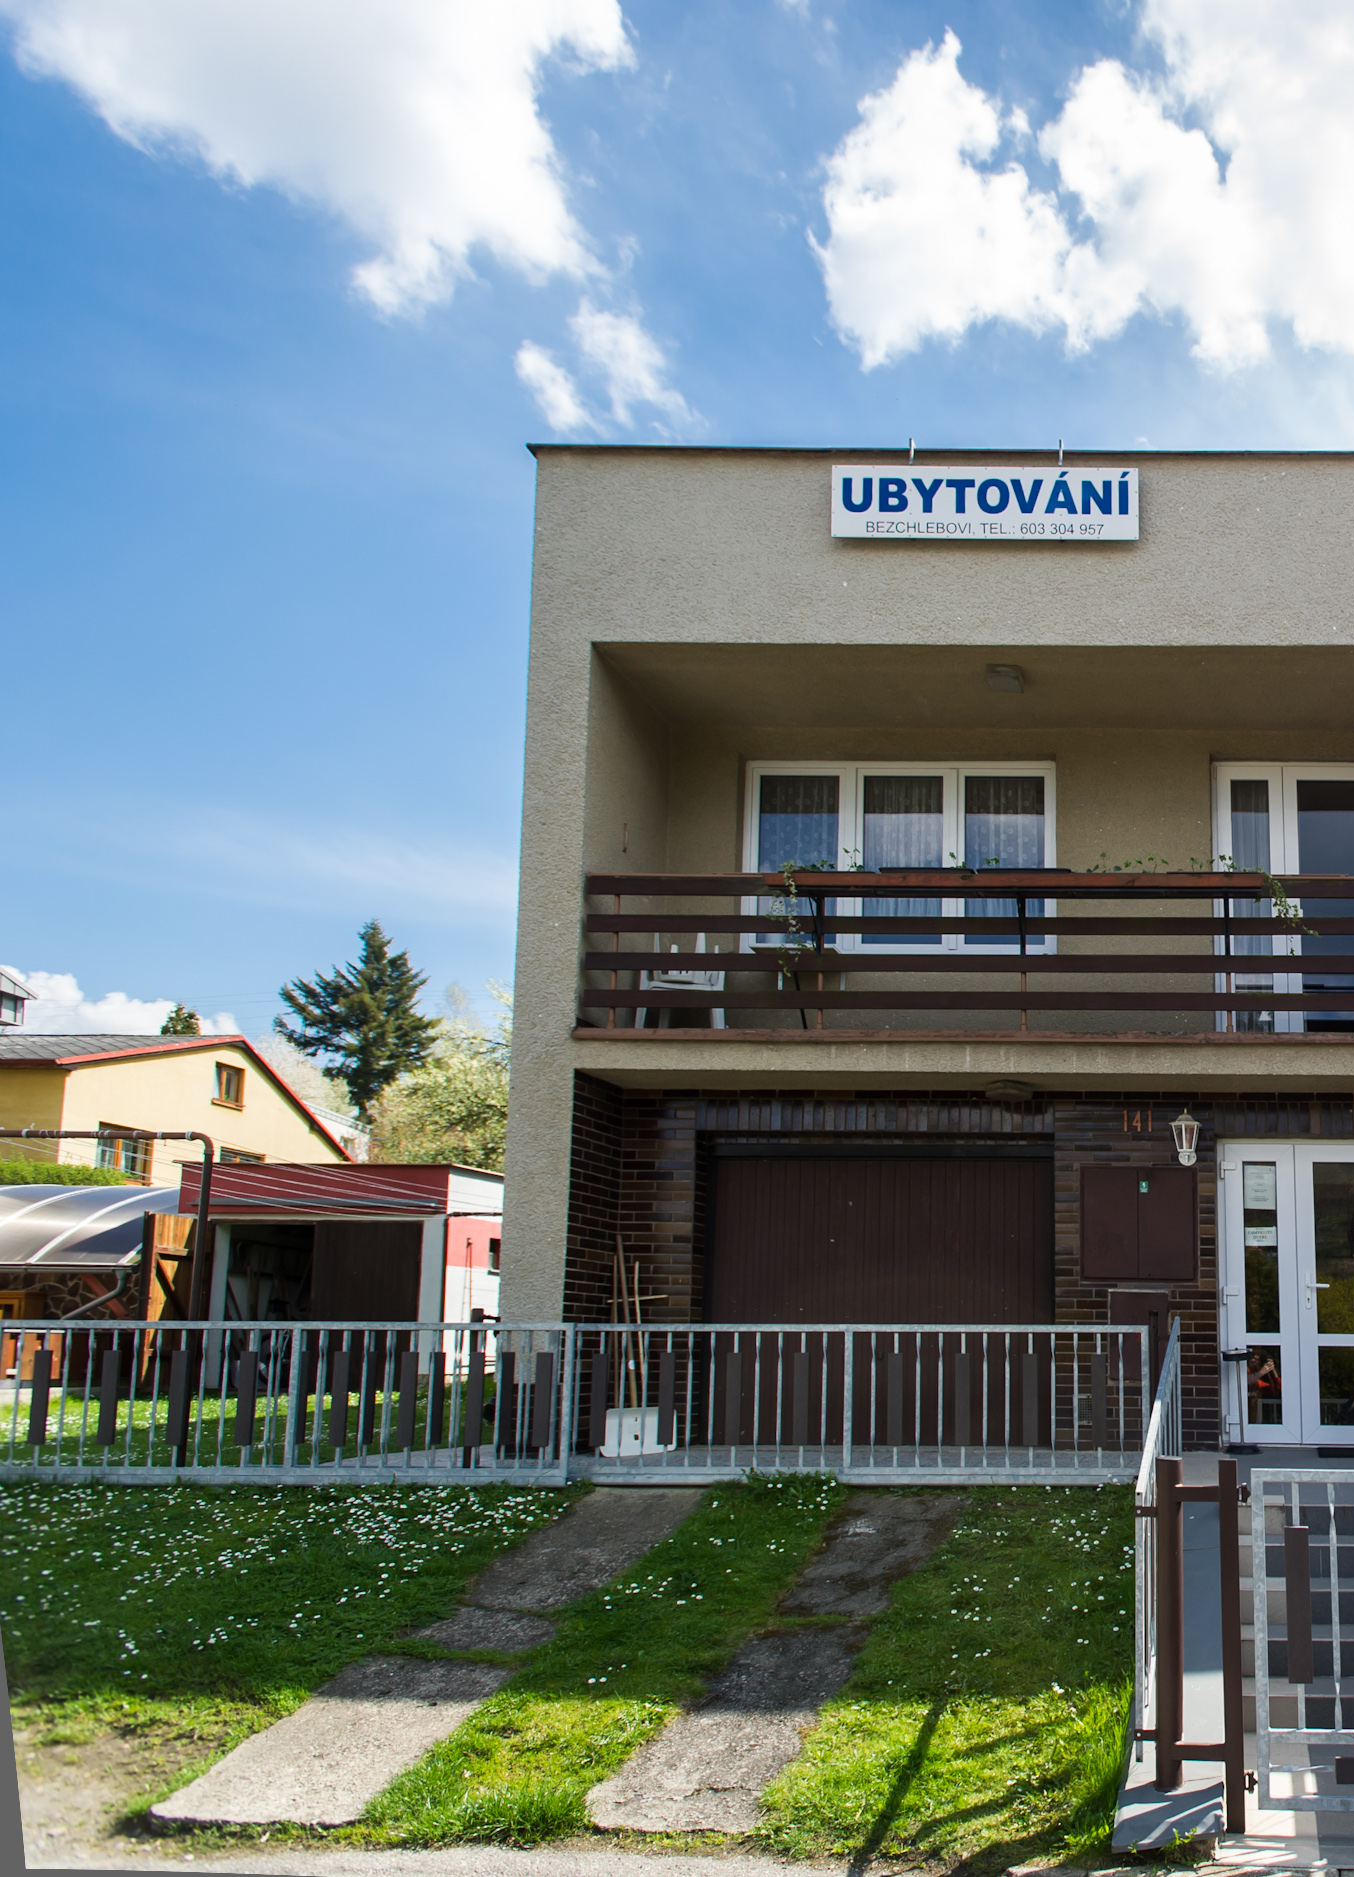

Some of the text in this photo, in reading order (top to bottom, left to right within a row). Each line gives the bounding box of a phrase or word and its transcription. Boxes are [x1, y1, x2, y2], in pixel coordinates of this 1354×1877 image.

[842, 471, 1130, 516] UBYTOVÁNÍ
[866, 521, 1104, 536] BEZCHLEBOVI, TEL.: 603 304 957
[1123, 1110, 1152, 1132] 141
